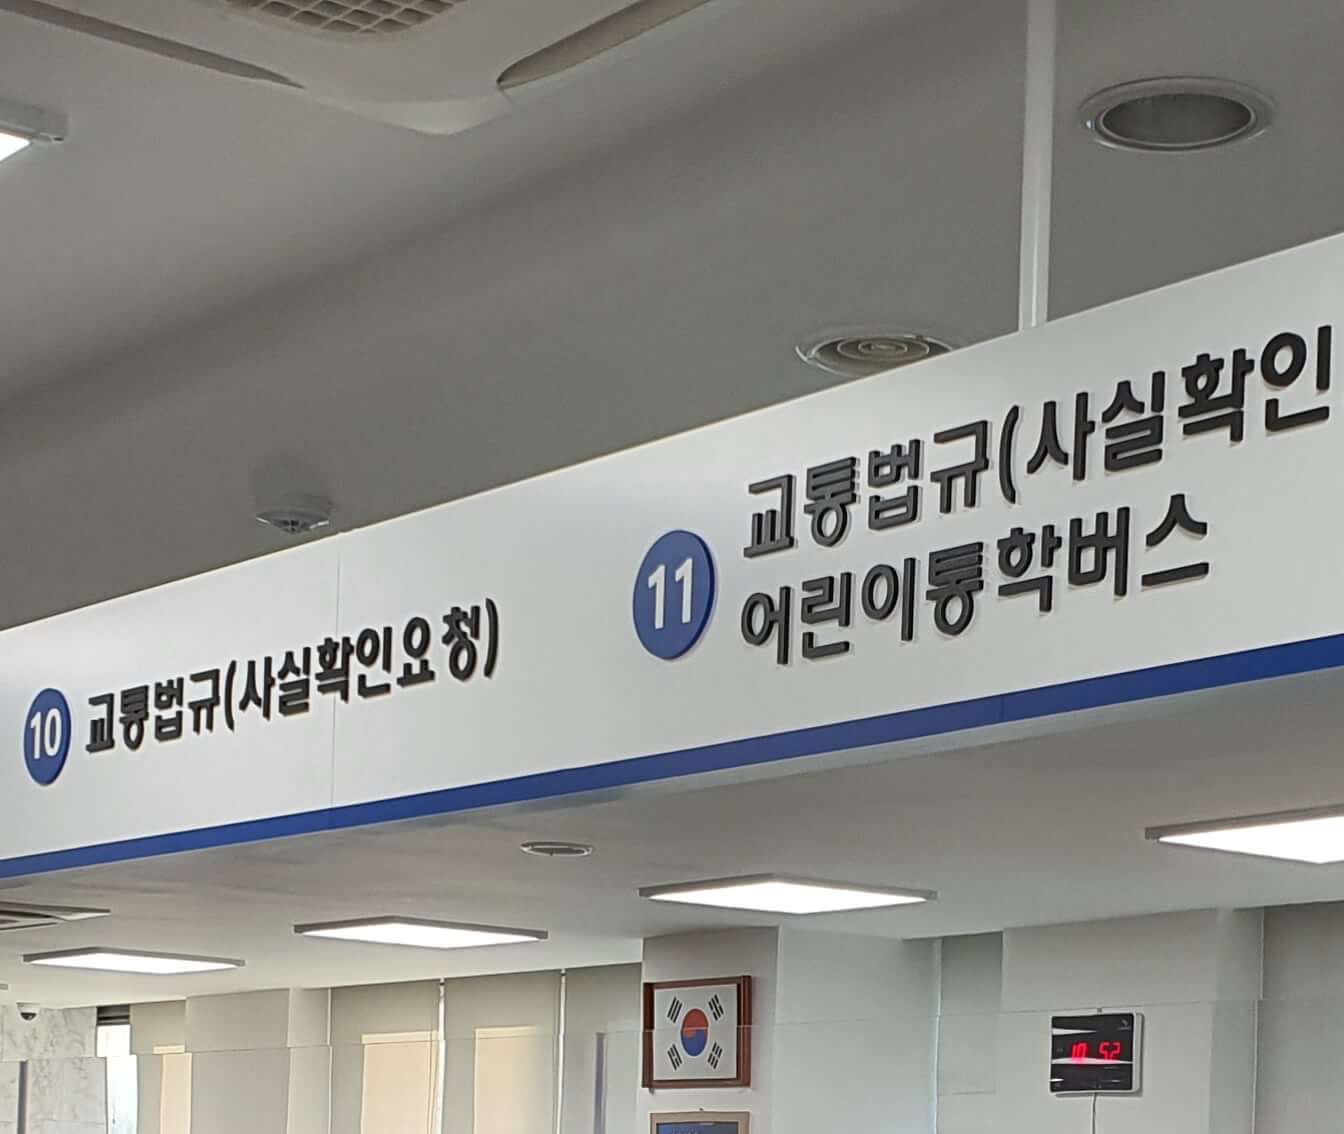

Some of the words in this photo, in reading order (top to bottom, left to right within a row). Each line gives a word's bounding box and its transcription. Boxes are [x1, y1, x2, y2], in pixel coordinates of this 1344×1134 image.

[646, 556, 697, 630] 11
[740, 492, 1211, 667] 어린이통학버스
[30, 709, 62, 760] 10
[85, 597, 500, 754] 교통법규(사실확인요청)
